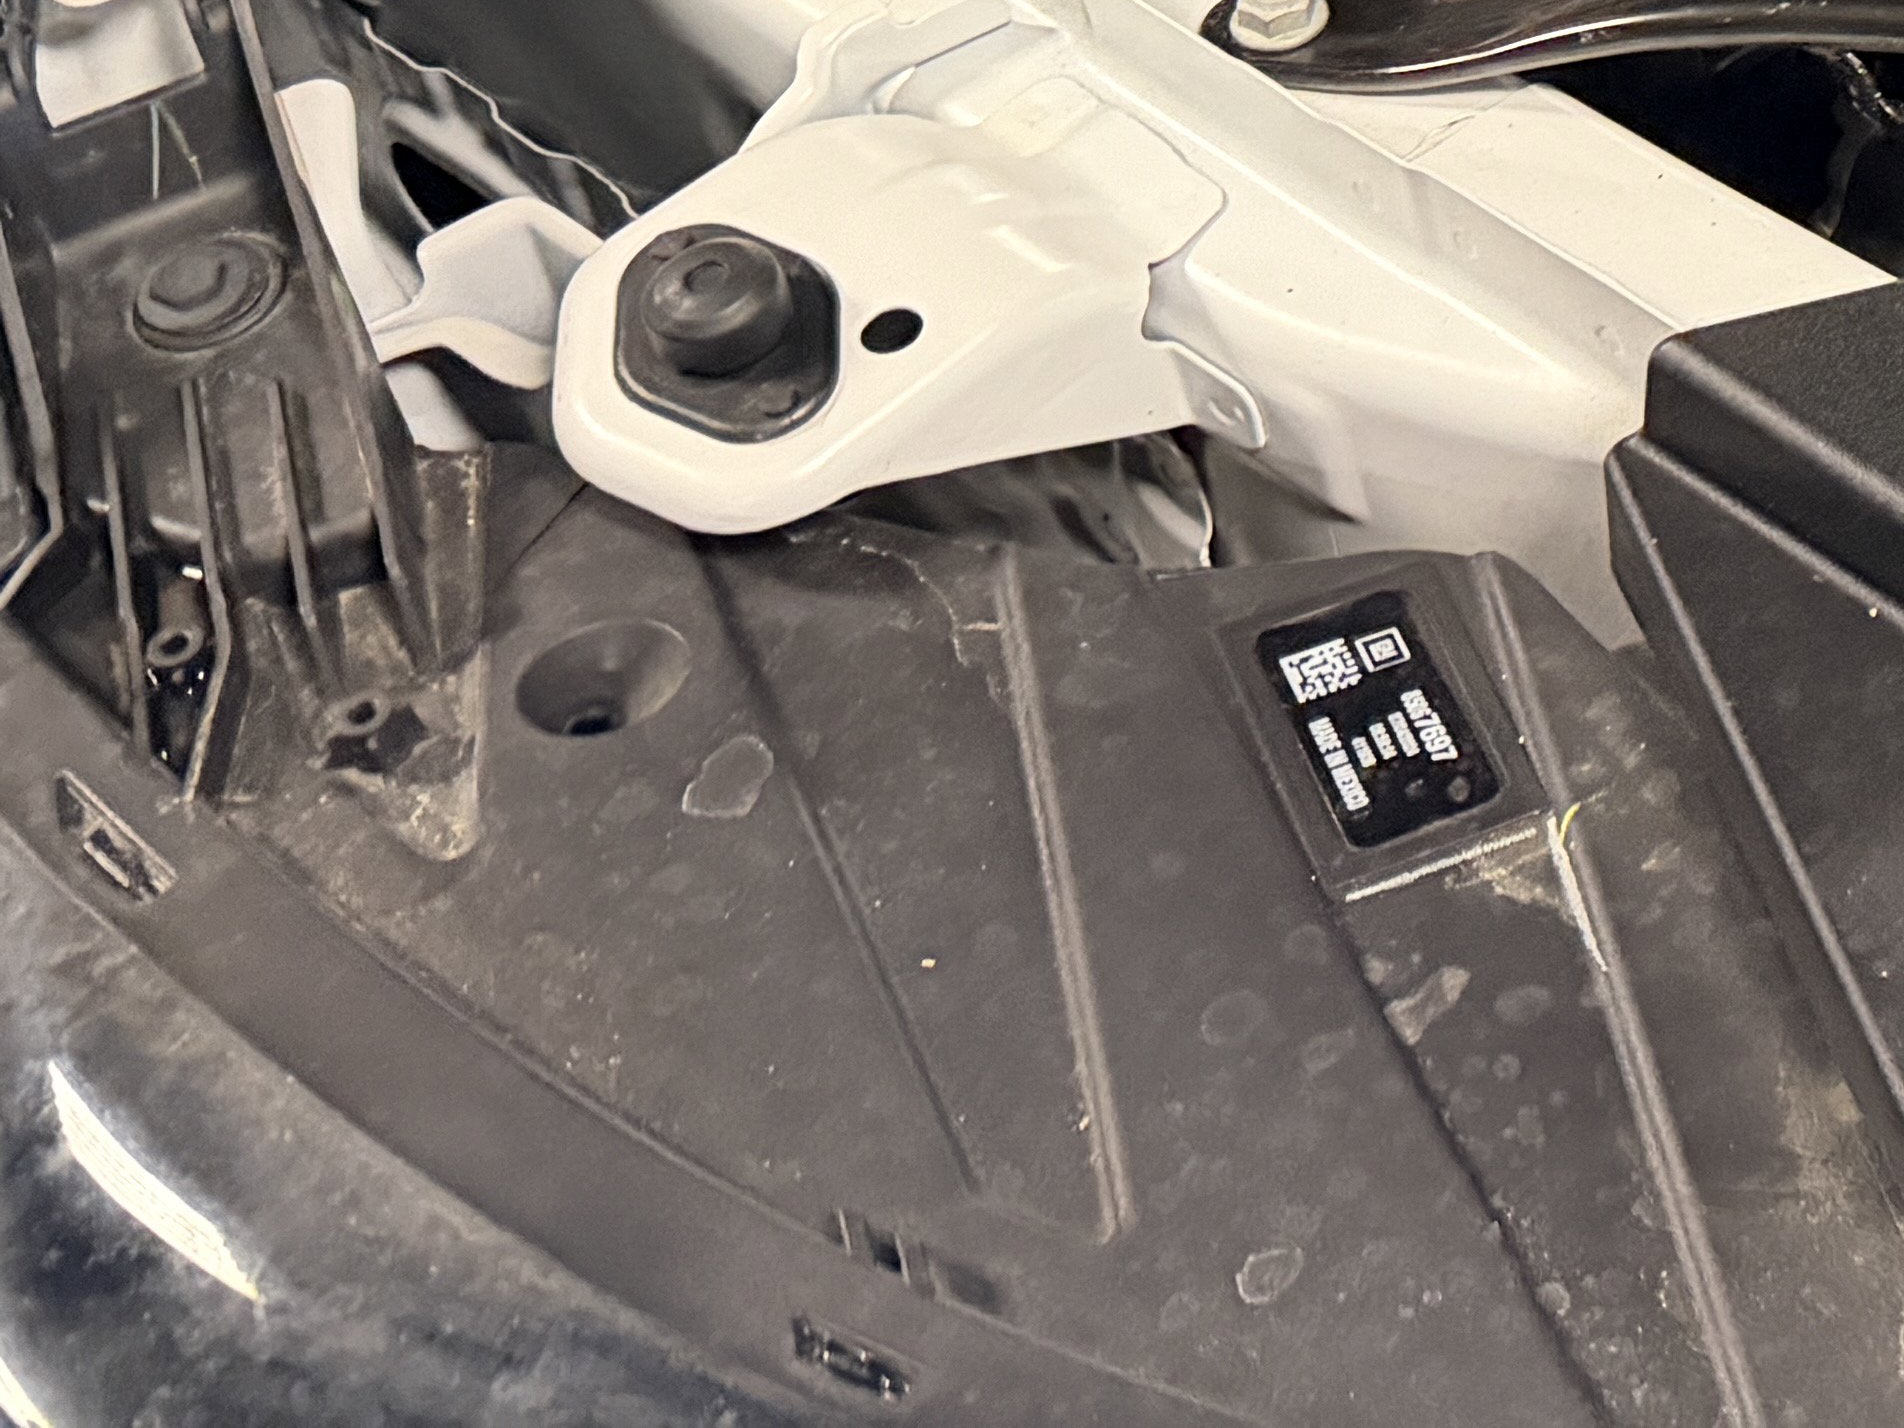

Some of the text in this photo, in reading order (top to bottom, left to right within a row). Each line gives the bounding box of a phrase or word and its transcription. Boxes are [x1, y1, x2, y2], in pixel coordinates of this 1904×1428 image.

[1308, 716, 1342, 754] MADE
[1324, 748, 1350, 769] IN
[1330, 763, 1370, 812] MEXICO
